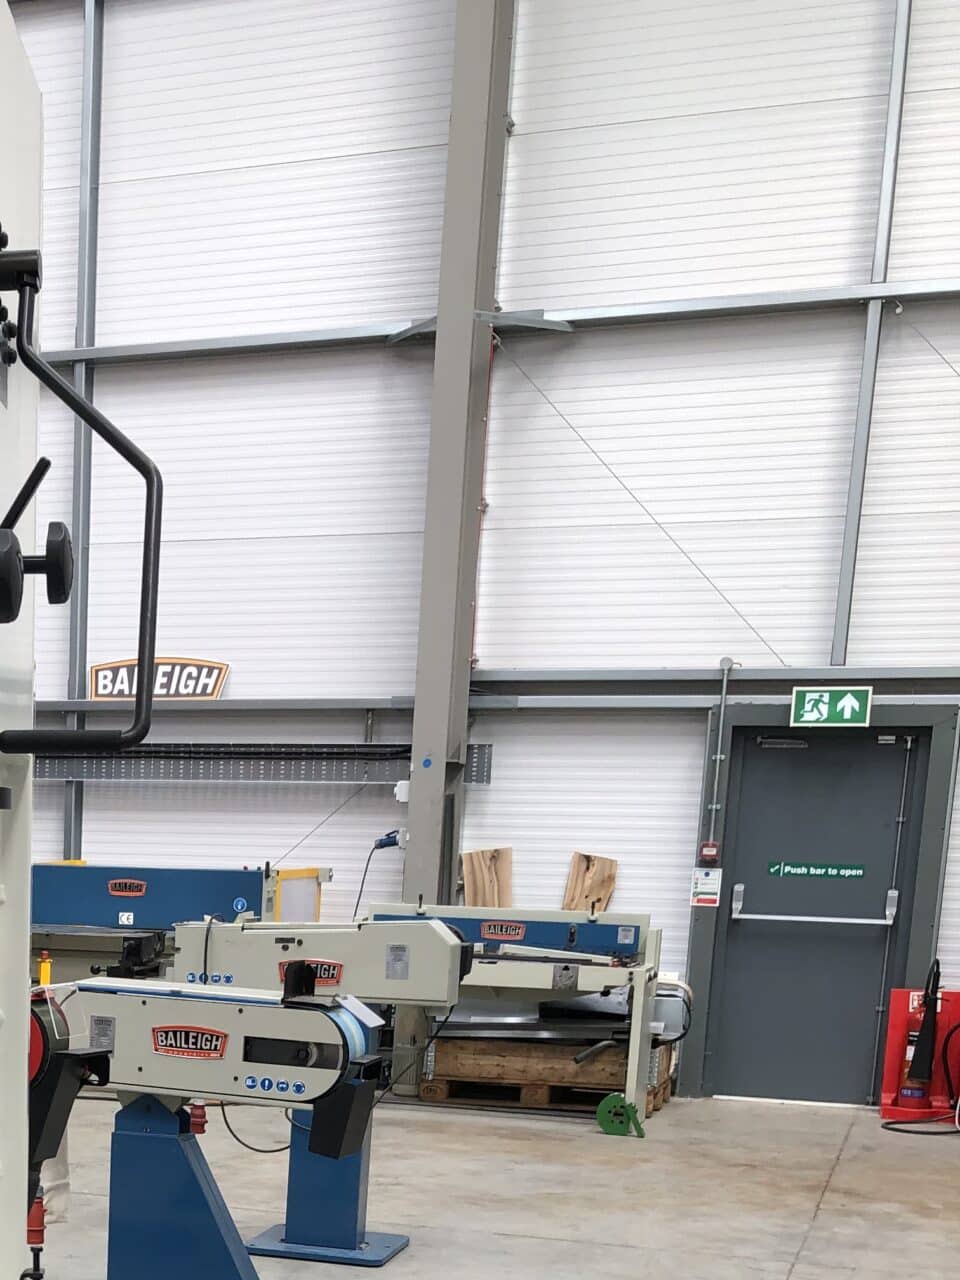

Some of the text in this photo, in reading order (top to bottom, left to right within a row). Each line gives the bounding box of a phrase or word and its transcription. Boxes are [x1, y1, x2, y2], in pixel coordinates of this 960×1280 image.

[97, 664, 220, 695] BAIEIGH
[784, 865, 863, 877] Push bar to open
[485, 924, 520, 936] BAILEIGH
[157, 1031, 222, 1050] BAILEIGH
